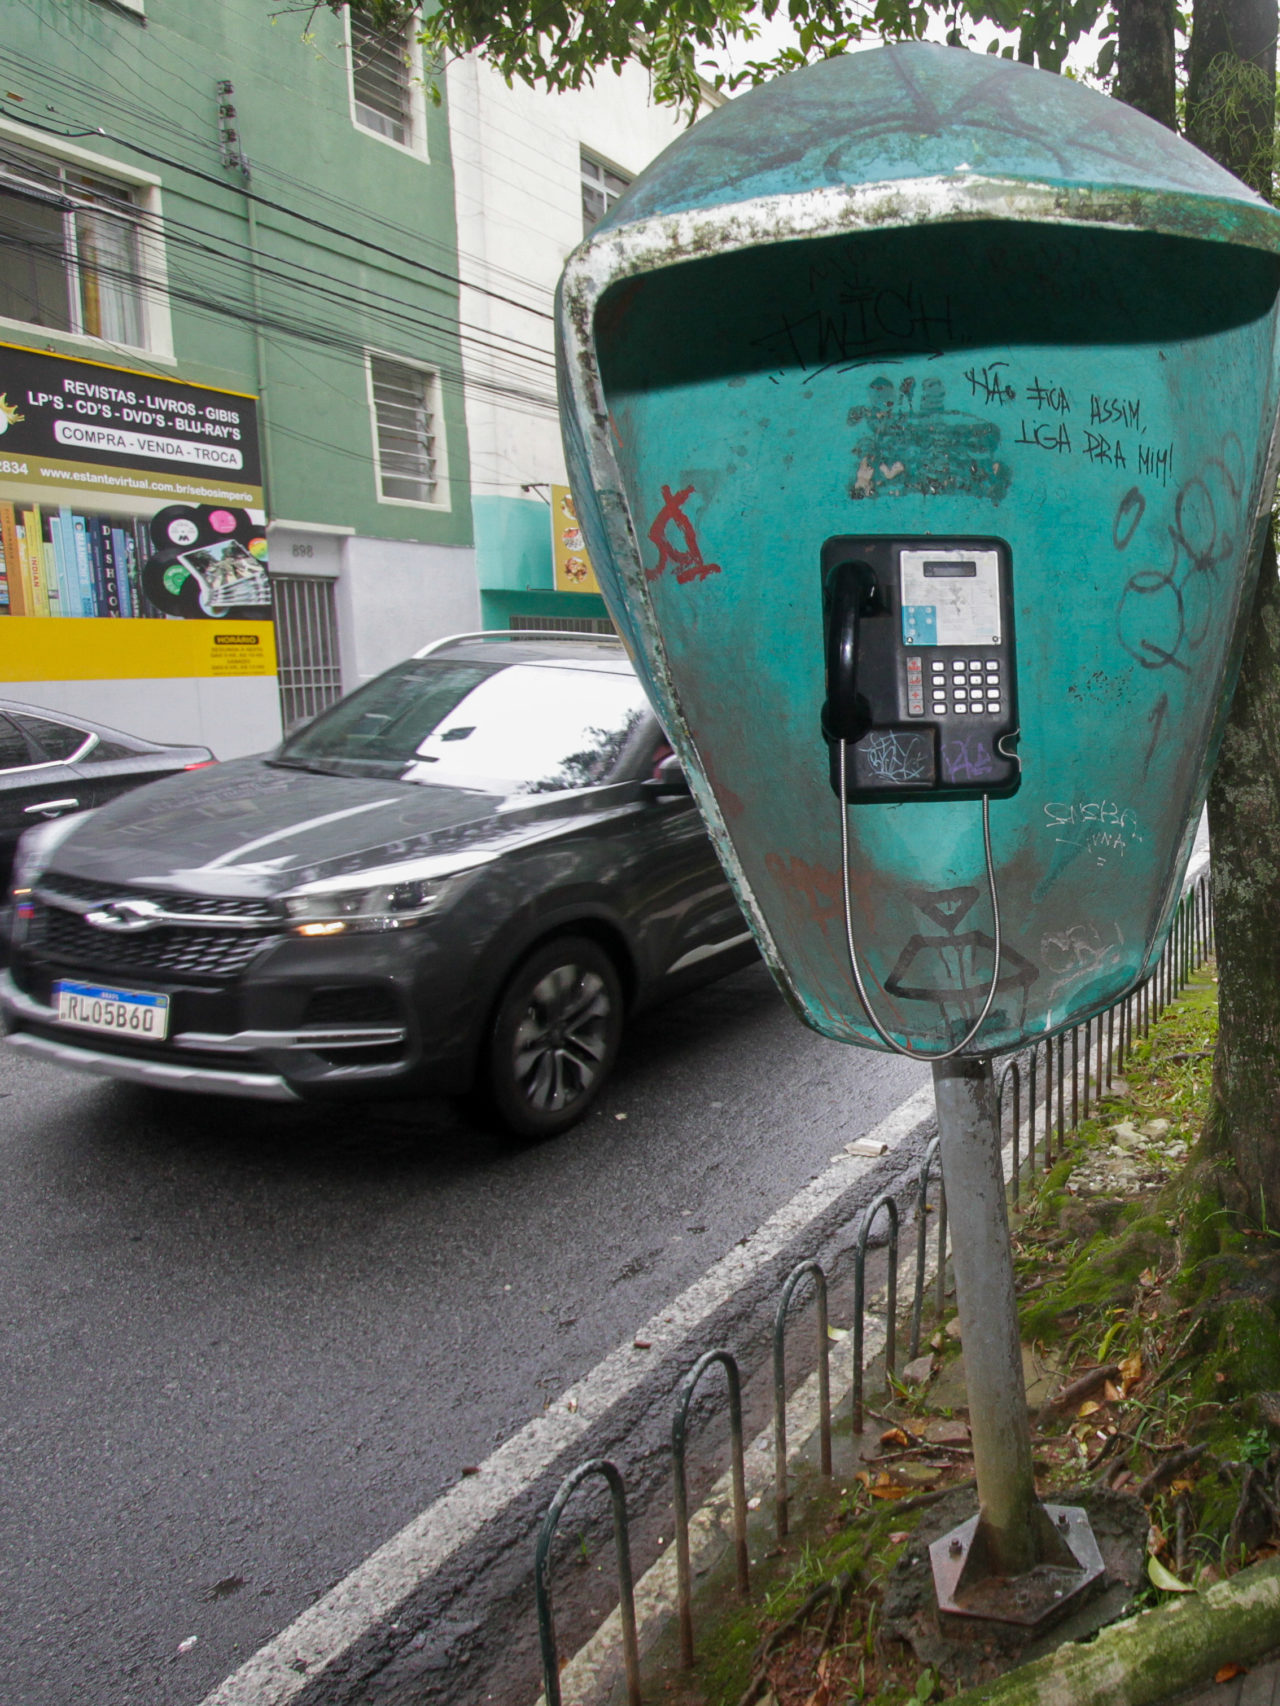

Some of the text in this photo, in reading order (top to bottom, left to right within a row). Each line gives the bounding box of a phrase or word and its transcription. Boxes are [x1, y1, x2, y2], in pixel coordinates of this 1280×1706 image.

[27, 391, 64, 410] LP'S
[76, 400, 112, 418] CD'S
[122, 408, 165, 428] DVD'S
[174, 417, 241, 441] BLU-RAY'S
[64, 379, 136, 405] REVISTAS
[146, 395, 196, 416] LIVROS
[204, 406, 240, 424] GIBIS
[62, 426, 127, 448] COMPRA
[137, 438, 184, 456] VENDA
[194, 447, 238, 465] TROCA
[40, 467, 254, 503] www.estantevirtual.com.br/sebosimperio
